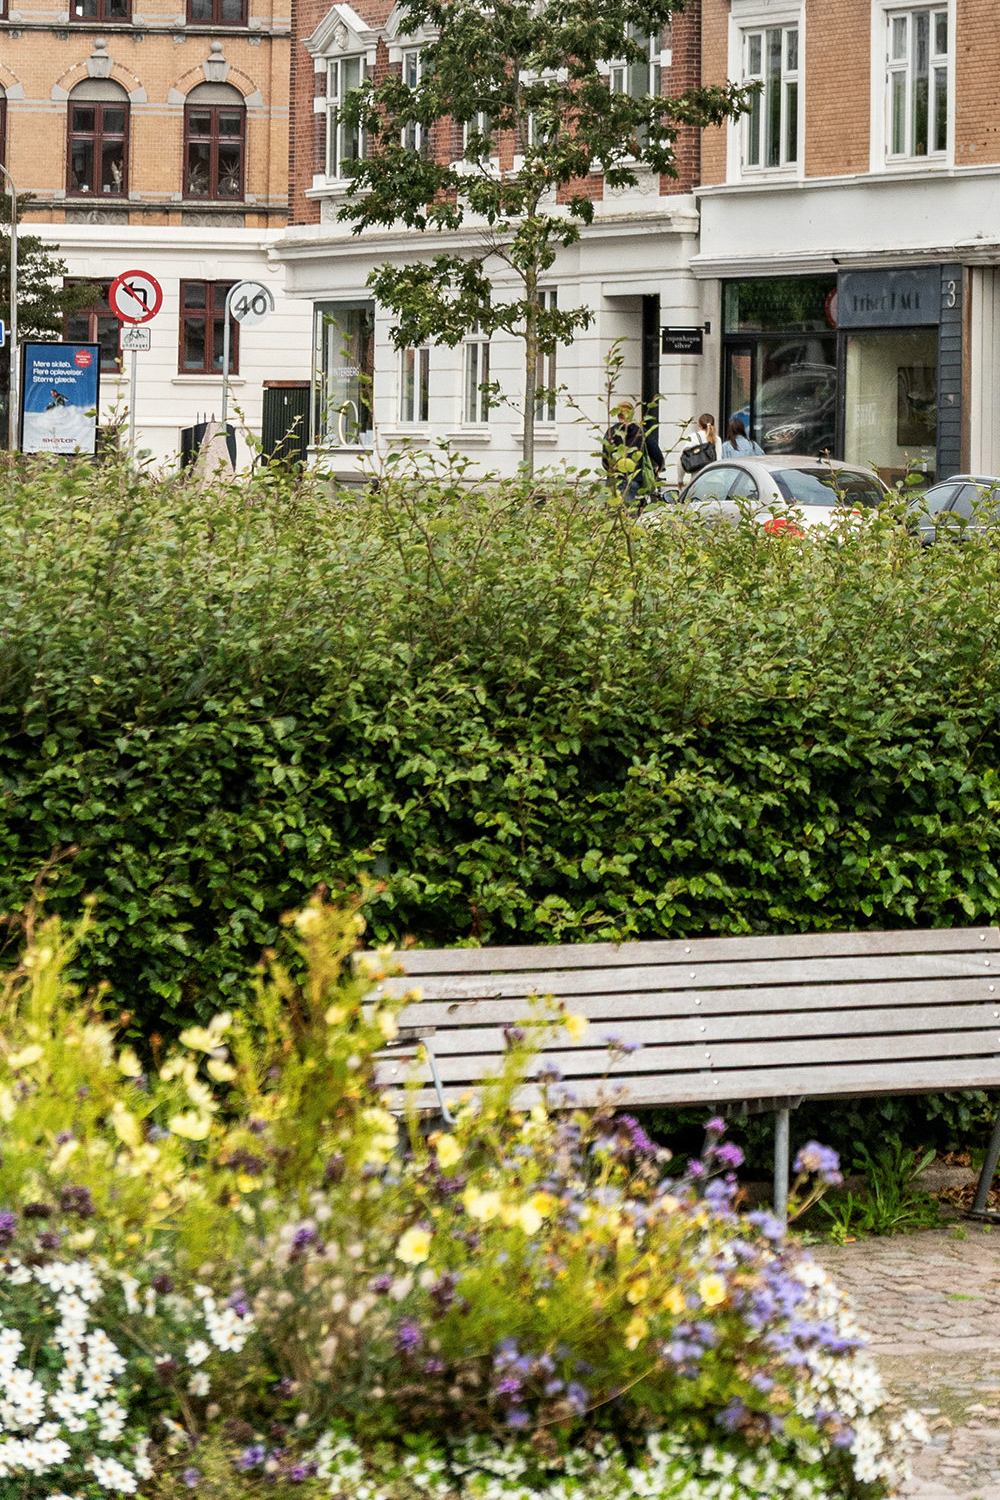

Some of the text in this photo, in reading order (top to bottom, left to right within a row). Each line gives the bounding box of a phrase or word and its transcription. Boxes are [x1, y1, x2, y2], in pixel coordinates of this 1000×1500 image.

[946, 280, 957, 308] 3
[234, 295, 267, 316] 40
[33, 360, 51, 368] Mere
